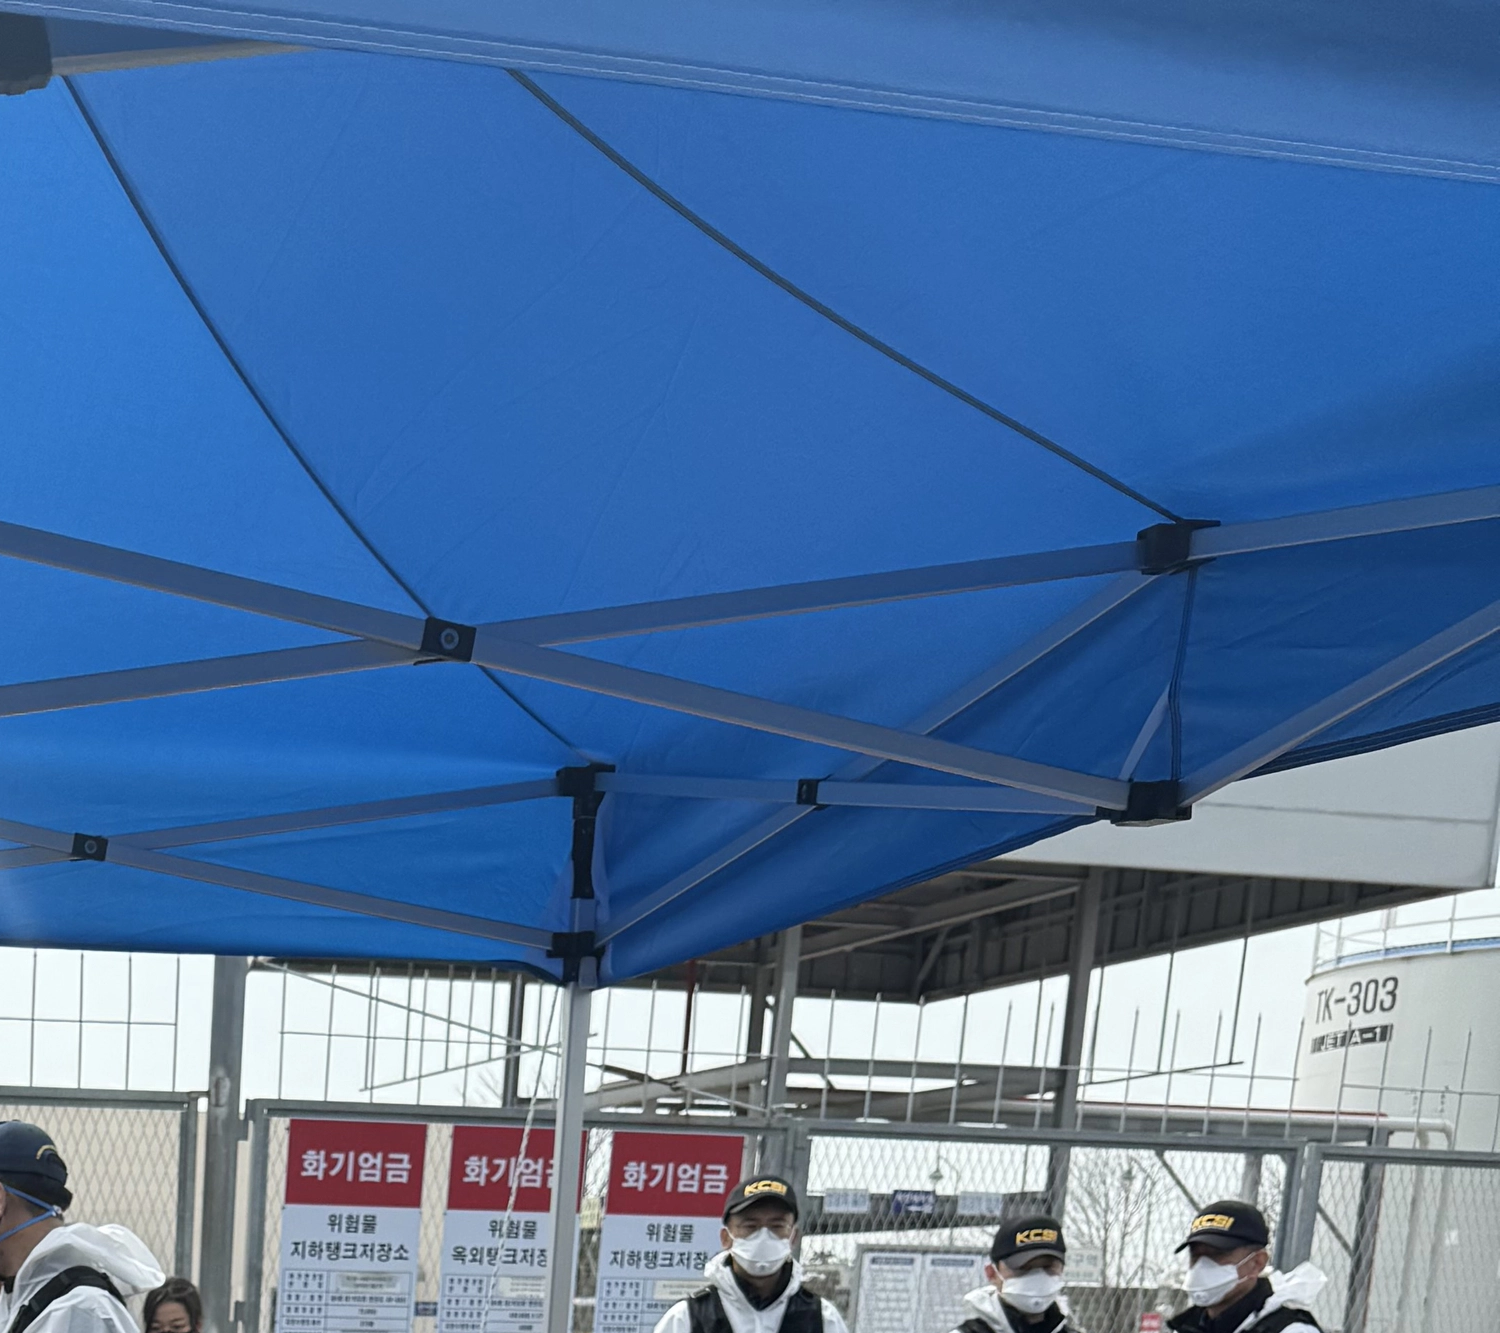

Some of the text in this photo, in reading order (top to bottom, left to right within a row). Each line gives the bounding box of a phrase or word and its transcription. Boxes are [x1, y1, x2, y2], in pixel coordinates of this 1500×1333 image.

[1315, 977, 1398, 1024] TK-303
[301, 1149, 412, 1184] 화기엄금
[622, 1161, 729, 1194] 화기엄금
[744, 1180, 788, 1197] KCSI
[327, 1213, 378, 1234] 위험물
[488, 1219, 538, 1240] 위험물
[646, 1222, 695, 1243] 위험물
[1191, 1214, 1235, 1231] KCSI
[1015, 1228, 1058, 1245] KCSI
[290, 1241, 411, 1262] 지하탱크저장소
[452, 1245, 548, 1268] 옥외탱크저장
[609, 1250, 709, 1271] 지하탱크저장
